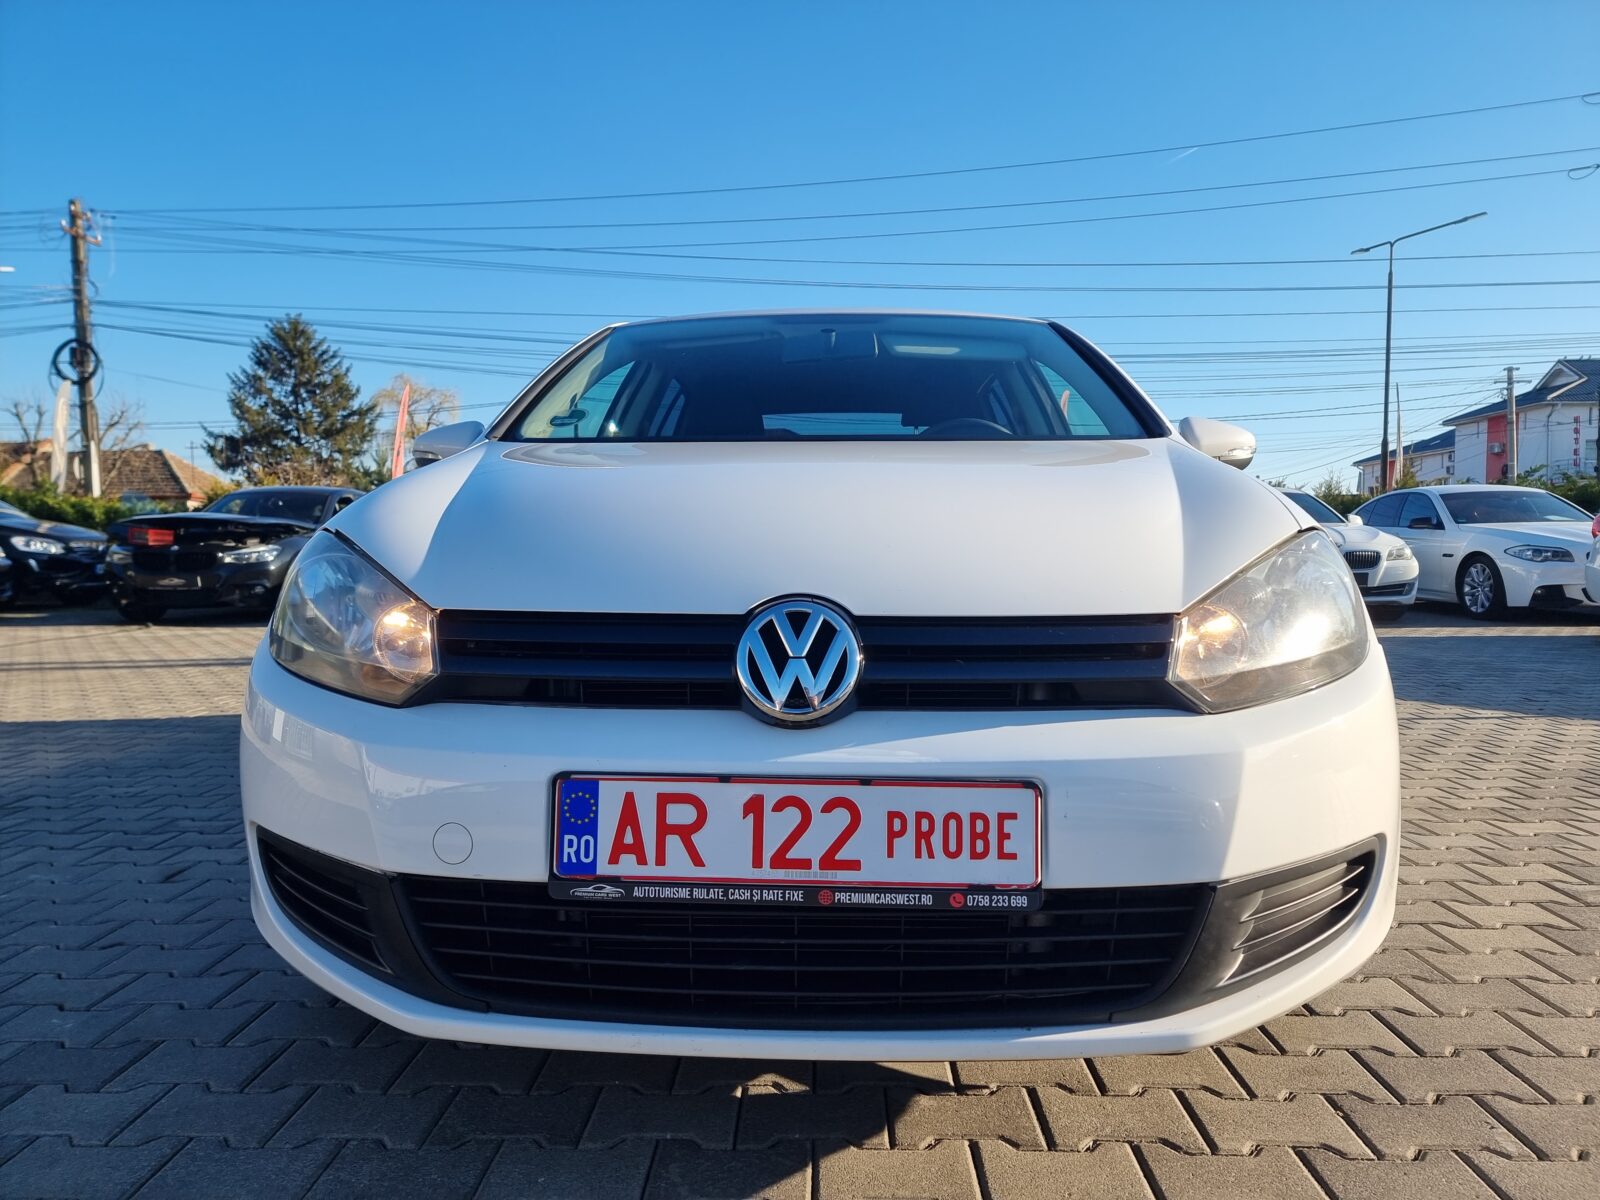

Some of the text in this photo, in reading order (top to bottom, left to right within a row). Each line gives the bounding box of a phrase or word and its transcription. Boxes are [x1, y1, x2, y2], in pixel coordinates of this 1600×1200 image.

[607, 791, 1018, 872] AR 122 PROBE
[562, 834, 595, 864] RO
[633, 886, 691, 899] AUTOTURISME
[693, 888, 727, 901] RULATE,
[728, 889, 751, 900] CASH
[762, 890, 784, 901] RATE
[785, 890, 804, 902] FIXE
[834, 892, 933, 906] PREMIUMCARSWEST.RO
[966, 894, 1028, 908] 0758 233 699
